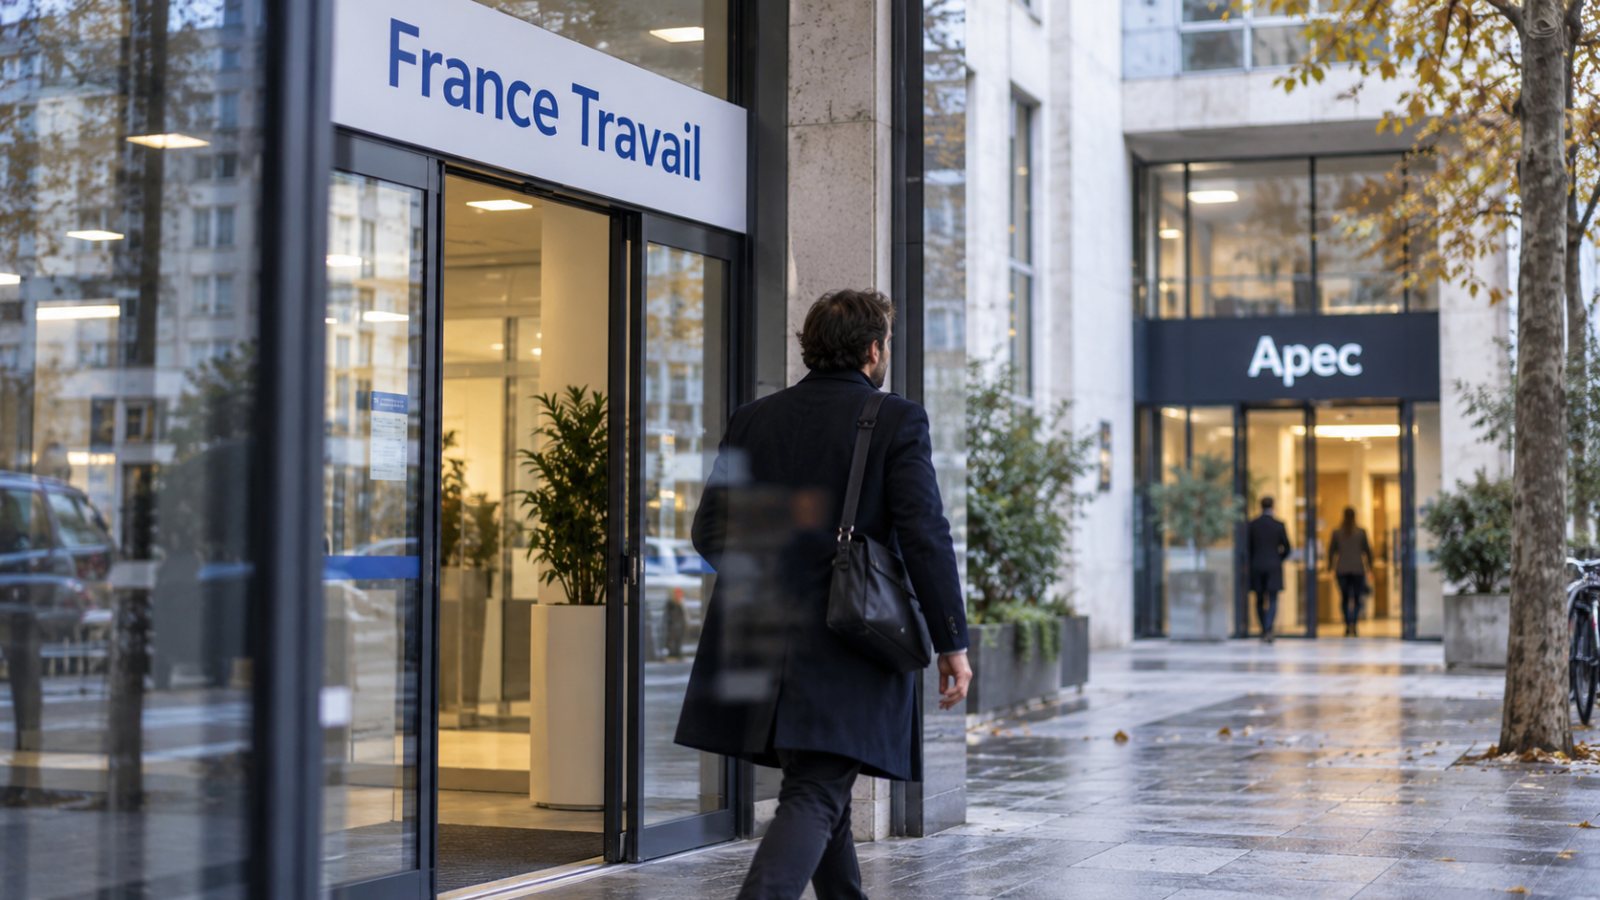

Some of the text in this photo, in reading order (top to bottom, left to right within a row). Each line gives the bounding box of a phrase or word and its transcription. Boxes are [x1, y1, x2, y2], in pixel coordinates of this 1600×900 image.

[388, 18, 702, 182] France Travail
[1248, 335, 1363, 387] Apec
